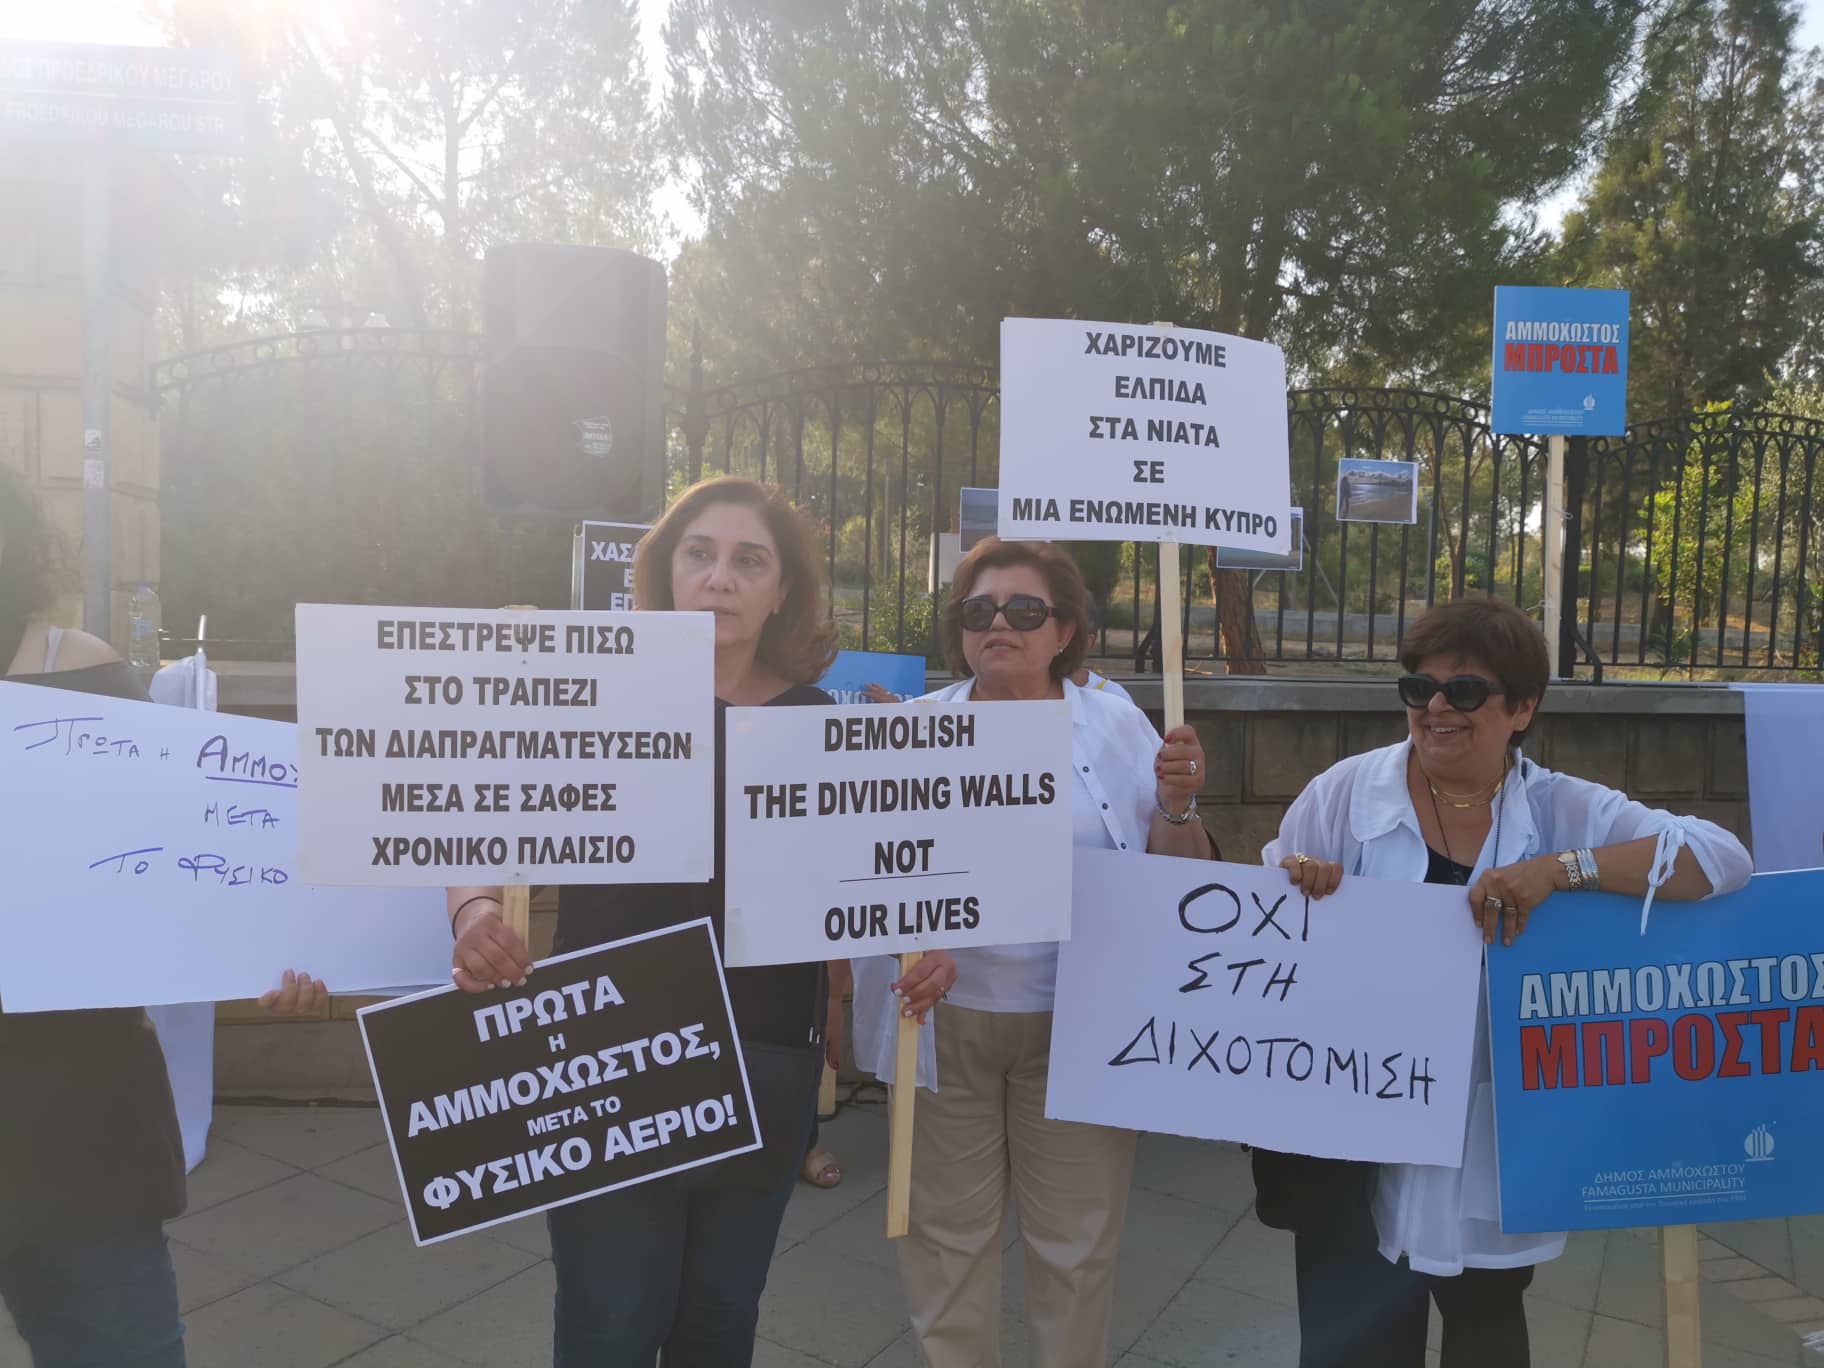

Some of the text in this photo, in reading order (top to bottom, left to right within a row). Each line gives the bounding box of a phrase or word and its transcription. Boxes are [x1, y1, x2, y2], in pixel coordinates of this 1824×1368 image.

[1084, 331, 1226, 368] ΧΑΡΙΖΟΥΜΕ
[1505, 320, 1620, 344] ΑΜΜΟΧΩΣΤΟΣ
[1504, 343, 1619, 375] ΜΠΡΟΣΤΑ
[1115, 375, 1207, 406] ΕΛΠΙΔΑ
[1089, 415, 1220, 448] ΣΤΑ ΝΙΑΤΑ
[1133, 460, 1165, 484] ΣΕ
[1012, 497, 1277, 538] ΜΙΑ ΕΝΩΜΕΝΗ ΚΥΠΡΟ
[377, 620, 634, 655] ΕΠΕΣΤΡΕΨΕ ΠΙΣΩ
[405, 676, 598, 707] ΣΤΟ ΤΡΑΠΕΖΙ
[315, 728, 692, 760] ΤΩΝ ΔΙΑΠΡΑΓΜΑΤΕΥΣΕΩΝ
[824, 714, 975, 752] DEMOLISH
[382, 783, 617, 812] ΜΕΣΑ ΣΕ ΣΑΦΕΣ
[744, 772, 1055, 819] THE DIVIDING WALLS
[204, 802, 280, 829] ΜΕΤΑ
[89, 847, 289, 886] ΤΟ ΦΥΣΙΚΟ
[371, 835, 635, 866] ΧΡΟΝΙΚΟ ΠΛΑΙΣΙΟ
[874, 839, 935, 875] NOT
[824, 896, 980, 941] OUR LIVES
[1178, 883, 1311, 942] ΟΧΙ
[1178, 952, 1298, 1002] ΣΤΗ
[473, 975, 625, 1042] ΠΡΩΤΑ
[548, 1033, 566, 1052] Η
[1108, 1016, 1437, 1105] ΔΙΧΟΤΟΜΙΣΗ
[1519, 1004, 1824, 1091] ΜΠΡΟΣΤΑ
[407, 1022, 720, 1138] ΑΜΜΟΧΩΣΤΟΣ,
[527, 1096, 621, 1136] ΜΕΤΑ ΤΟ
[423, 1094, 738, 1210] ΦΥΣΙΚΟ ΑΕΡΙΟ!
[1581, 1176, 1745, 1199] FAMAGUSTA MUNICIPALITY
[1594, 1163, 1745, 1184] ΔΗΜΟΣ ΑΜΜΟΧΩΣΤΟΥ
